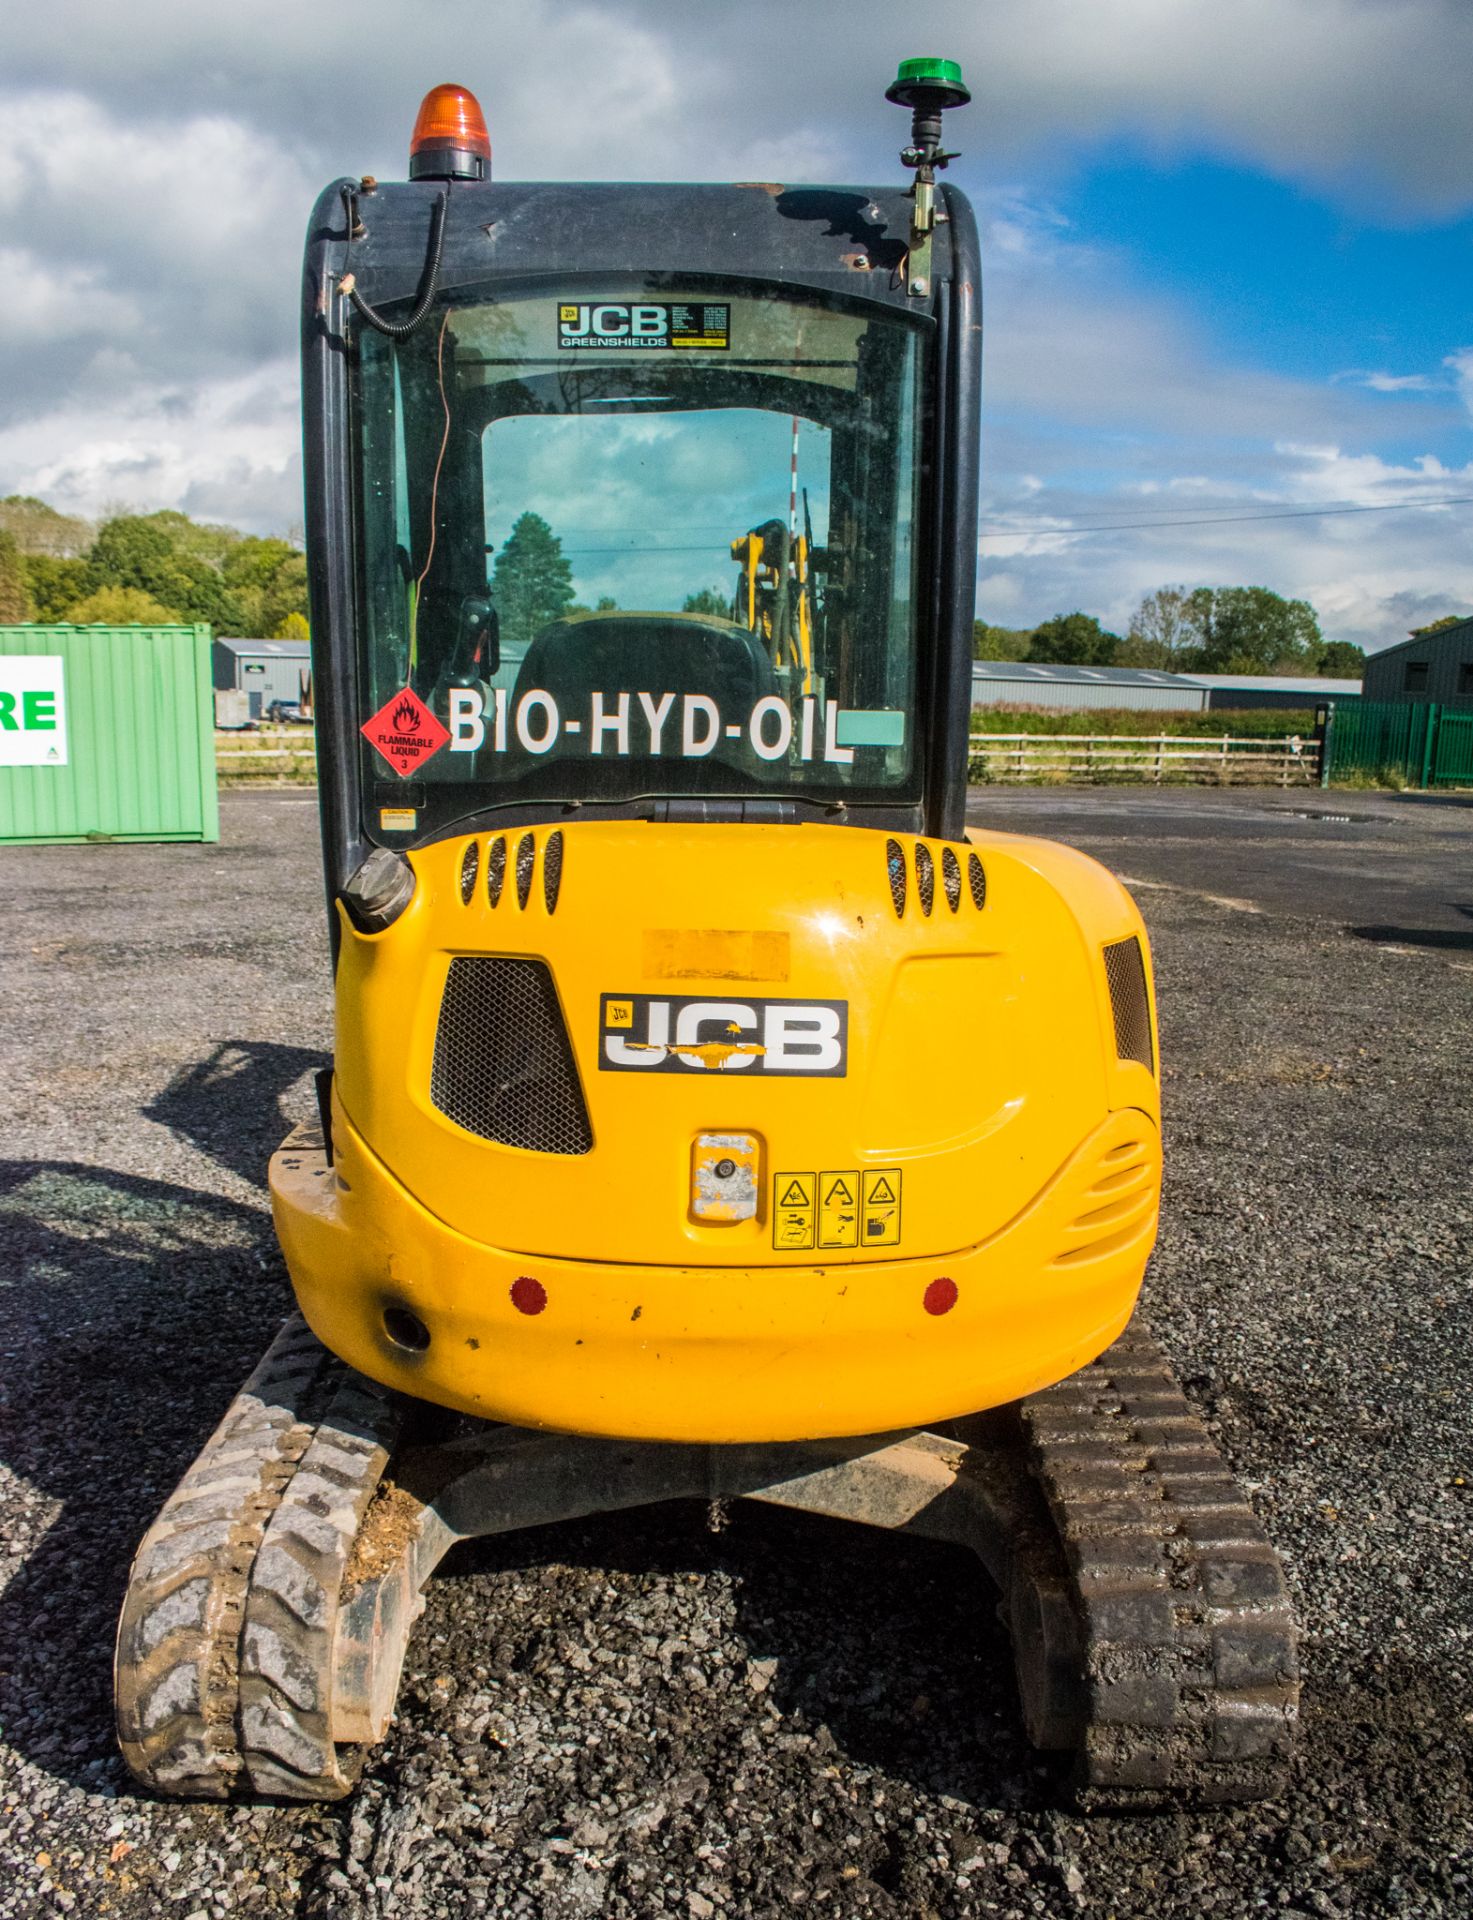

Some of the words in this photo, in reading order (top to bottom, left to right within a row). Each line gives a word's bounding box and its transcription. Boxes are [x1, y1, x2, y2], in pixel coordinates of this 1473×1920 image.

[561, 306, 668, 337] JCB
[561, 337, 667, 347] GREENSHIELDS
[448, 688, 855, 763] BIO-HYD-OIL
[378, 735, 434, 748] FLAMMABLE
[391, 746, 420, 757] LIQUID
[401, 760, 408, 769] 3
[605, 1001, 842, 1070] JCB
